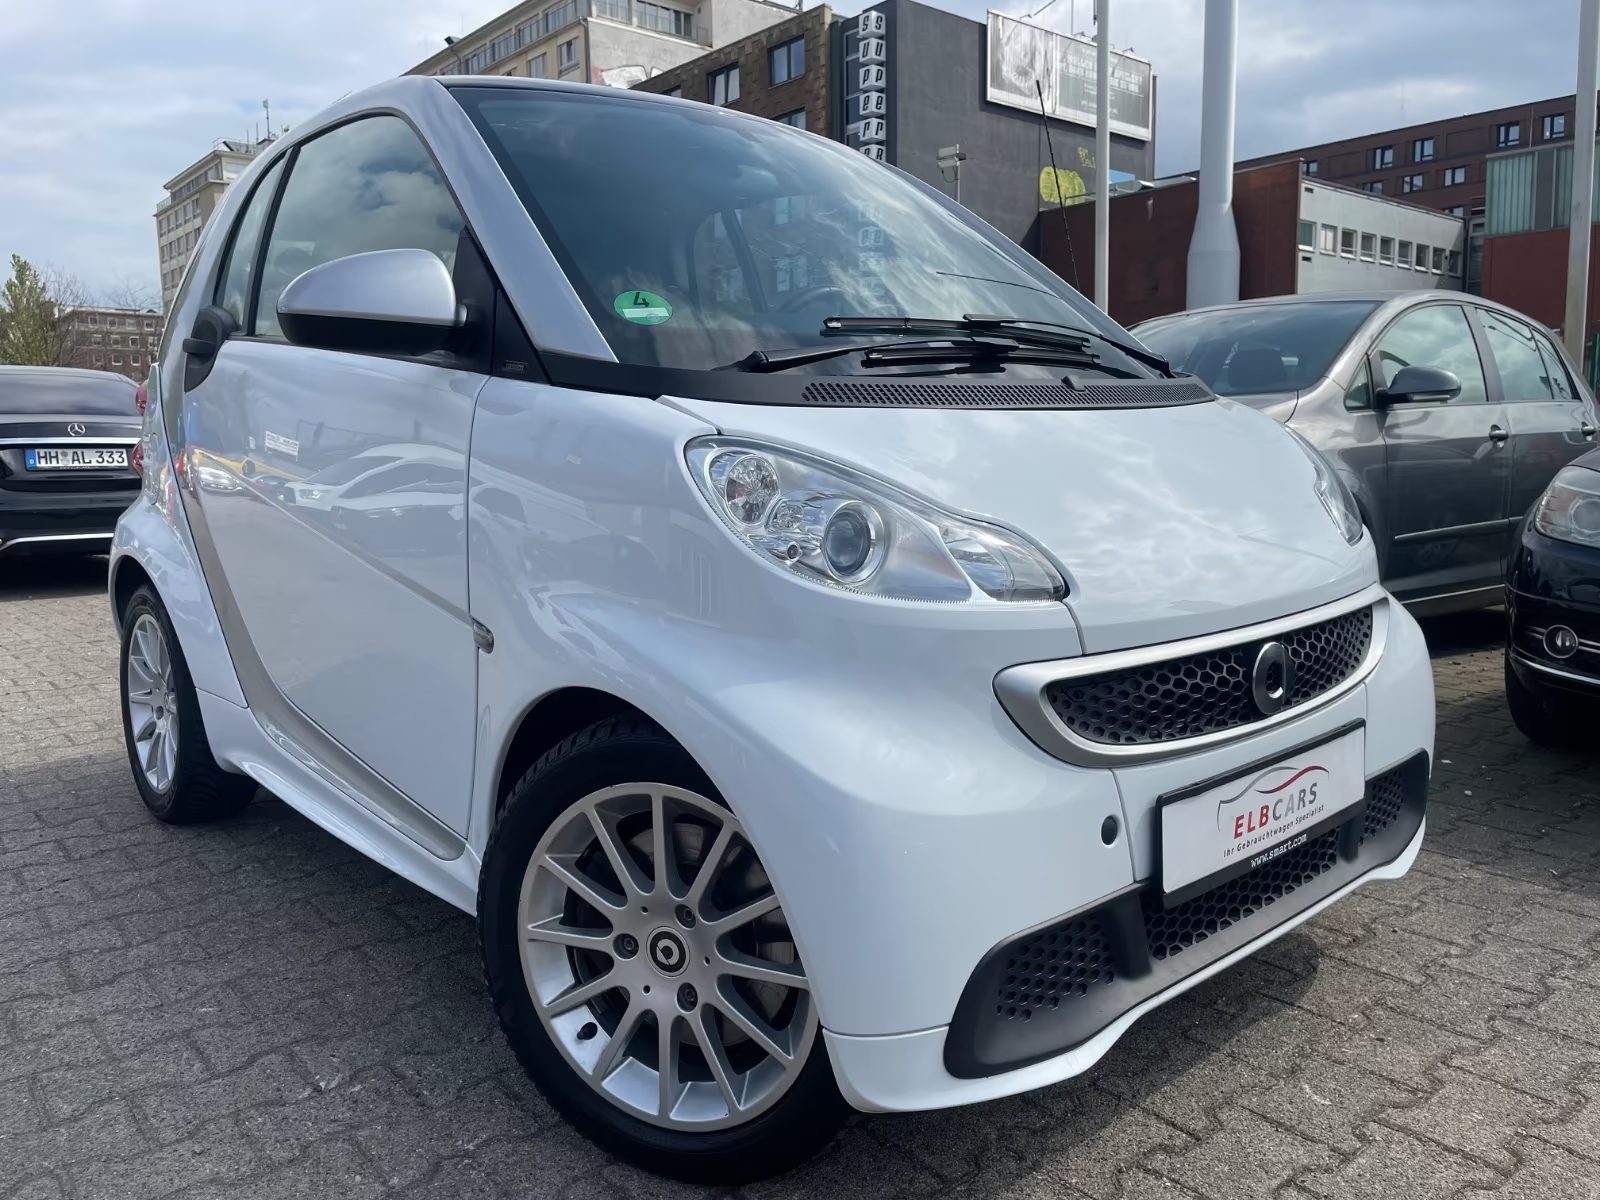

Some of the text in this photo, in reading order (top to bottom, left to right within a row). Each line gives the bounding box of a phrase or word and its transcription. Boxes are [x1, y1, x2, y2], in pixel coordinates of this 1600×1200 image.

[633, 291, 650, 307] 4
[36, 451, 59, 465] HH
[71, 451, 92, 465] AL
[95, 450, 125, 464] 333
[1233, 782, 1318, 840] ELBCARS
[1223, 804, 1325, 858] Ihr Gebrauchtwagen Spezialist
[1250, 833, 1308, 868] www.smart.com
